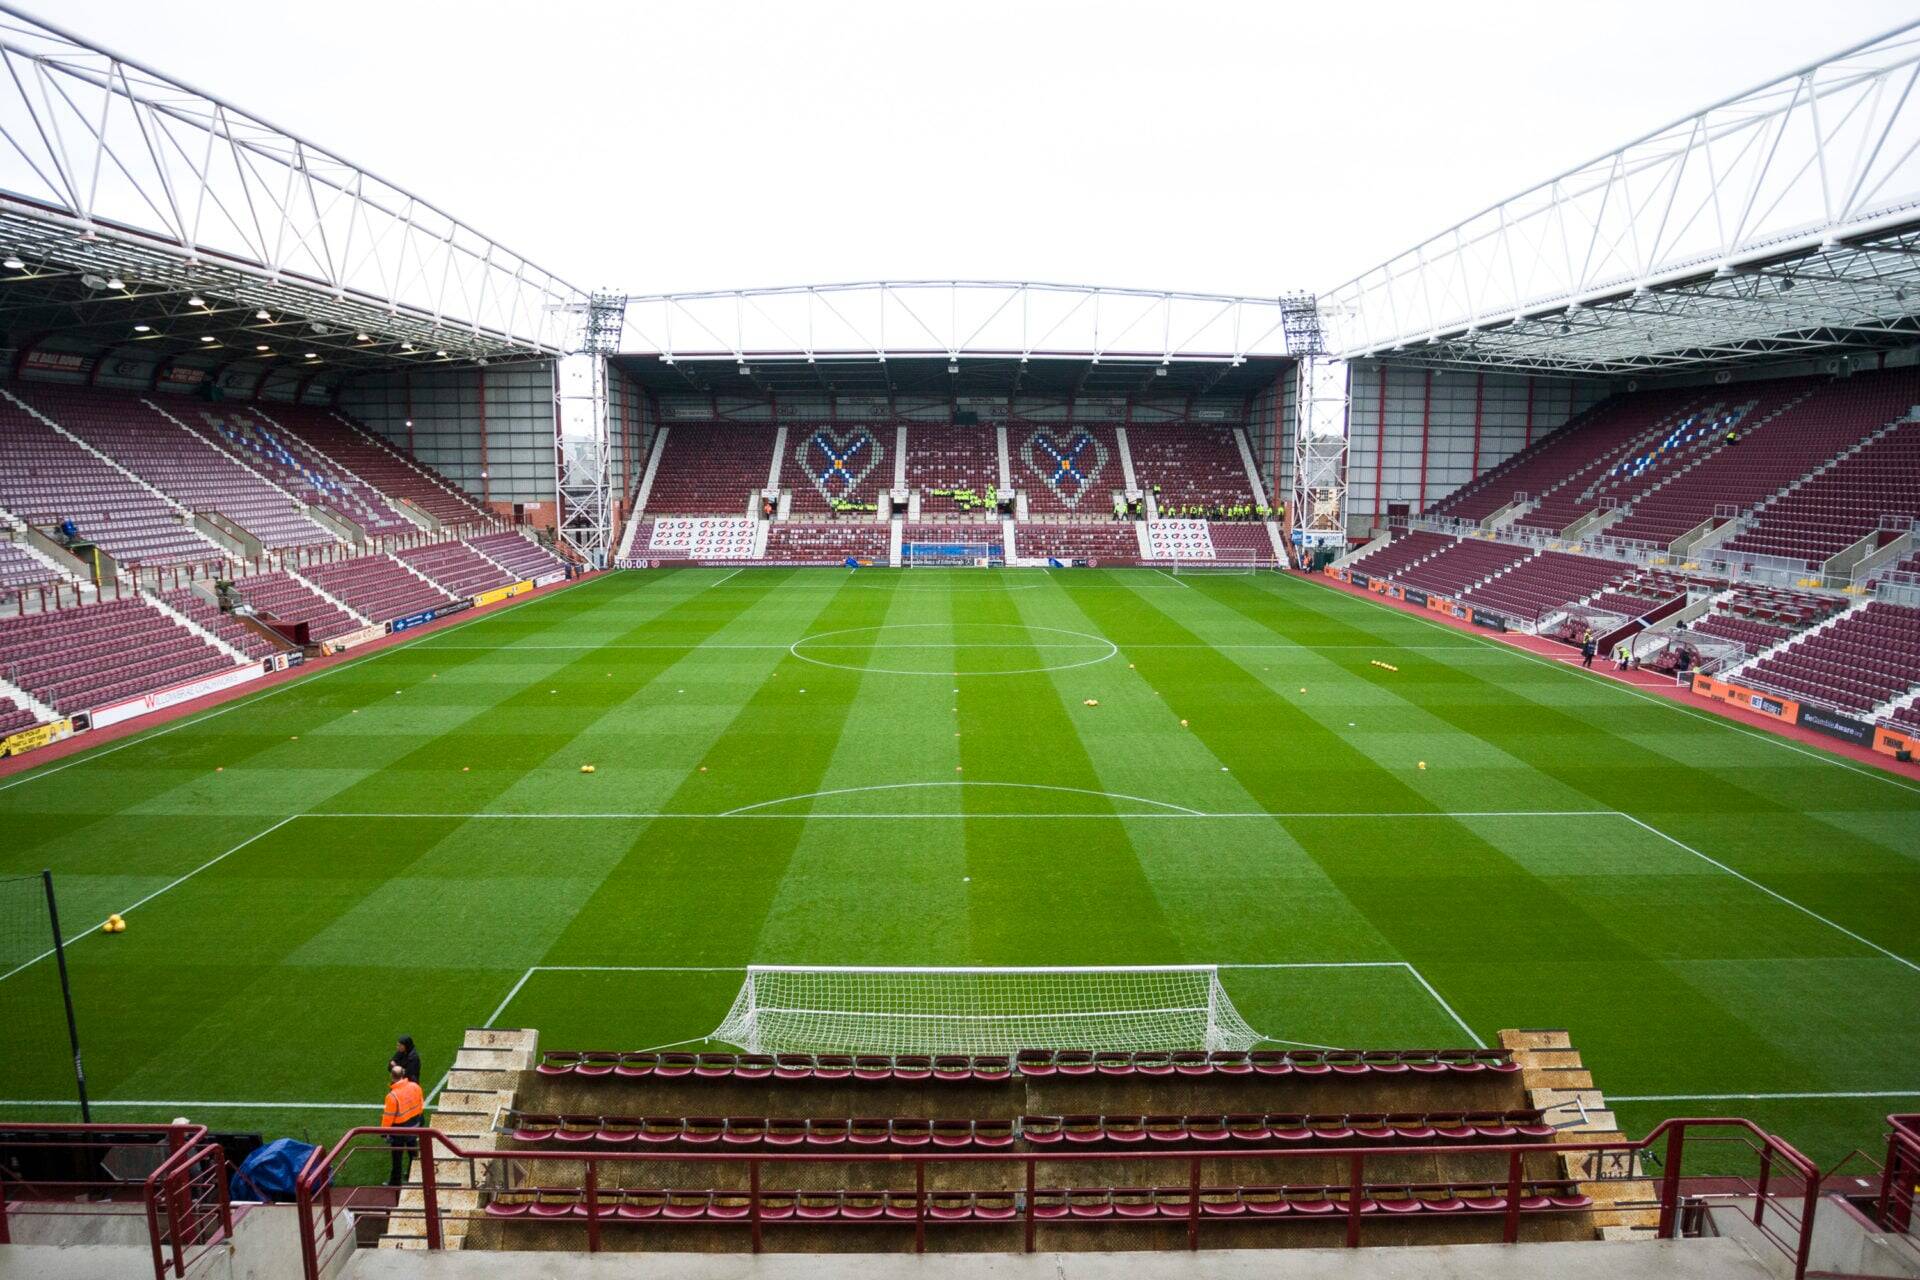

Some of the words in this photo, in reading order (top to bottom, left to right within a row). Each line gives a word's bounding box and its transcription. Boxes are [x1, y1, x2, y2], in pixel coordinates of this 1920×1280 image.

[620, 560, 648, 569] 00:00
[488, 1034, 495, 1044] 3
[463, 1096, 469, 1104] 4
[1611, 1153, 1623, 1169] X
